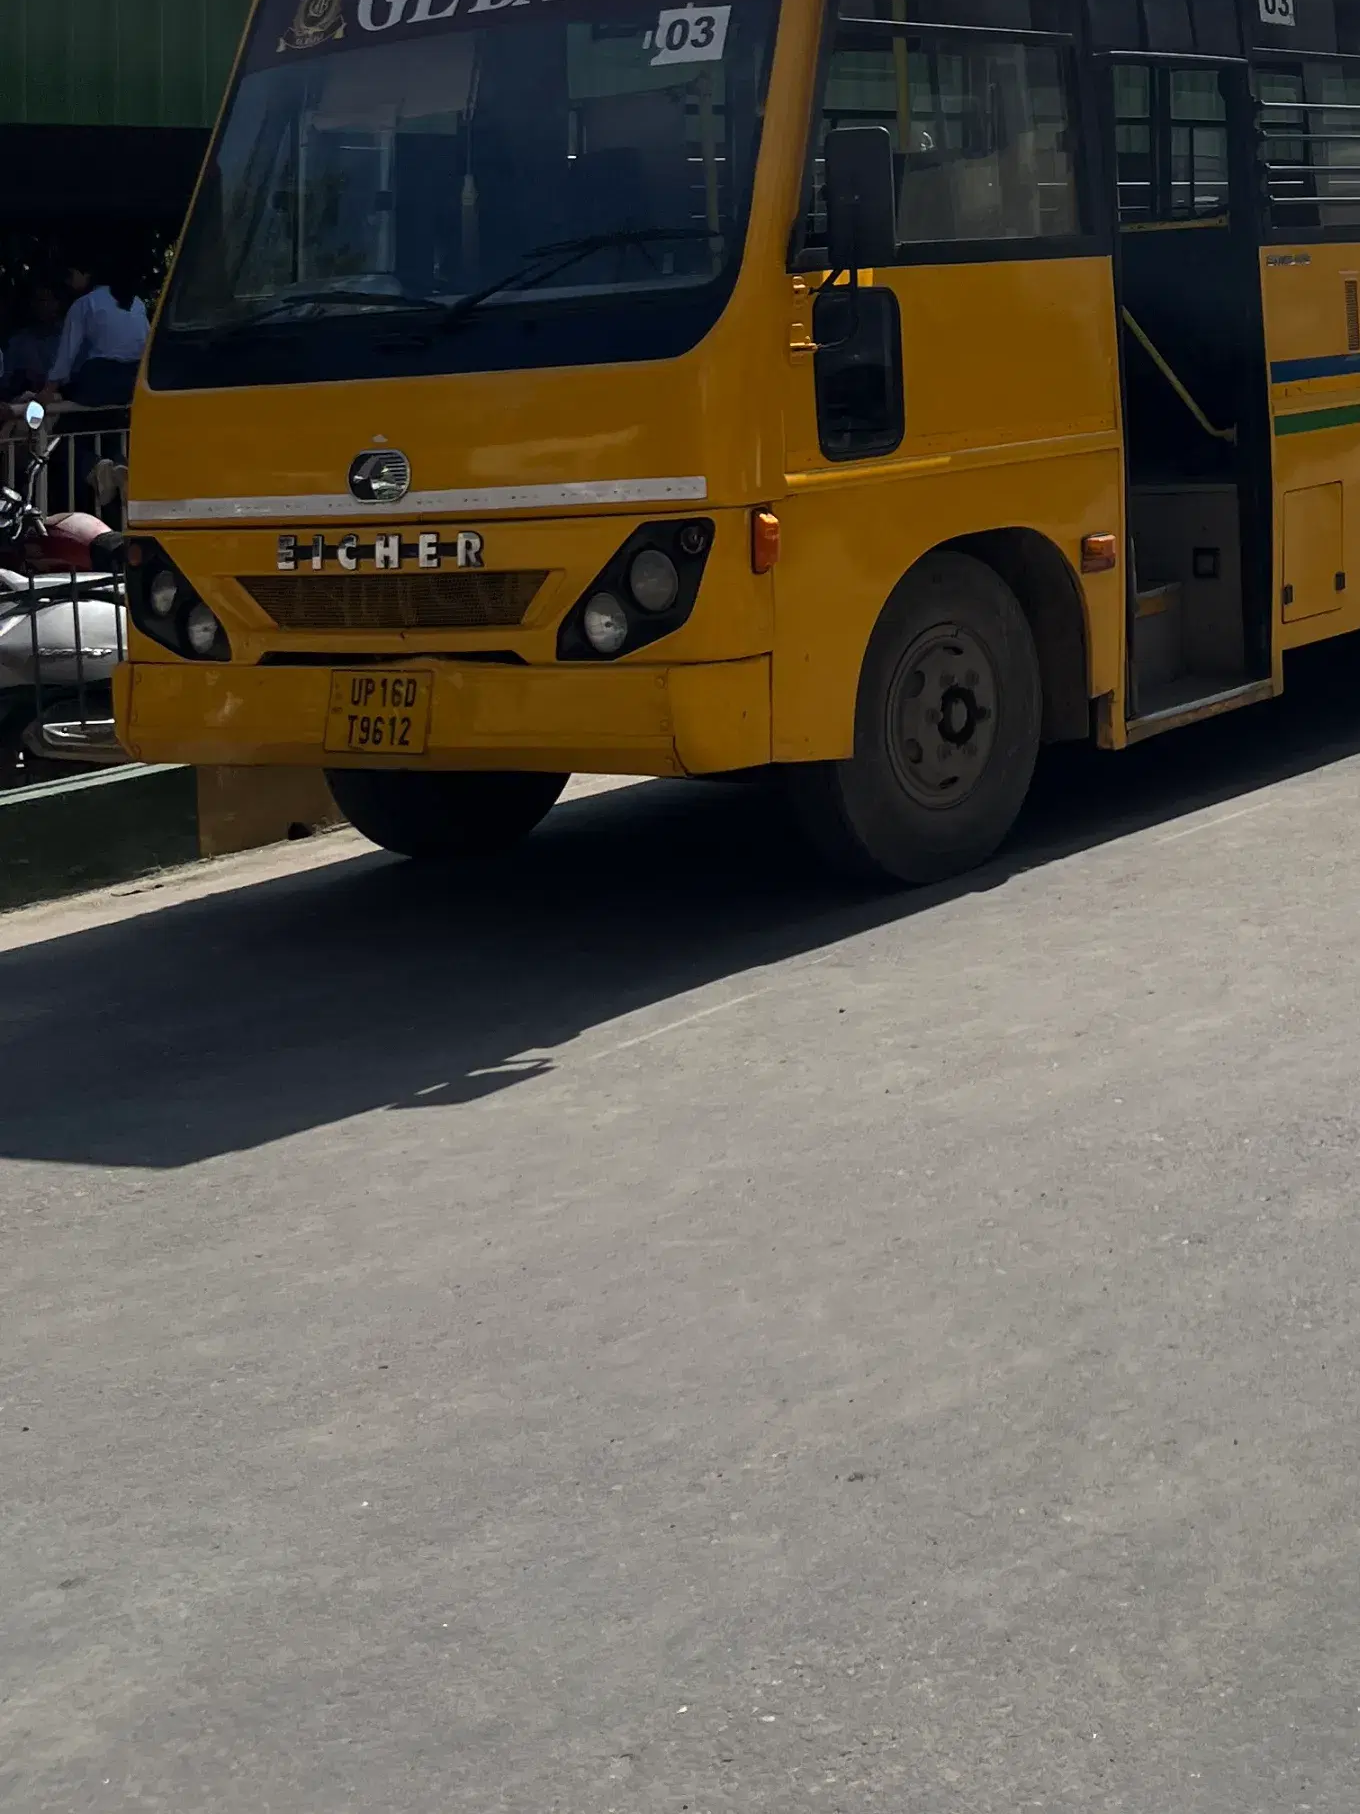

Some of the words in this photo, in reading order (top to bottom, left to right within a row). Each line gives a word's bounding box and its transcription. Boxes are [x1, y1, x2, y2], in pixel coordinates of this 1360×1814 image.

[665, 15, 716, 52] 03
[277, 531, 484, 570] EICHER
[348, 715, 411, 746] T9612
